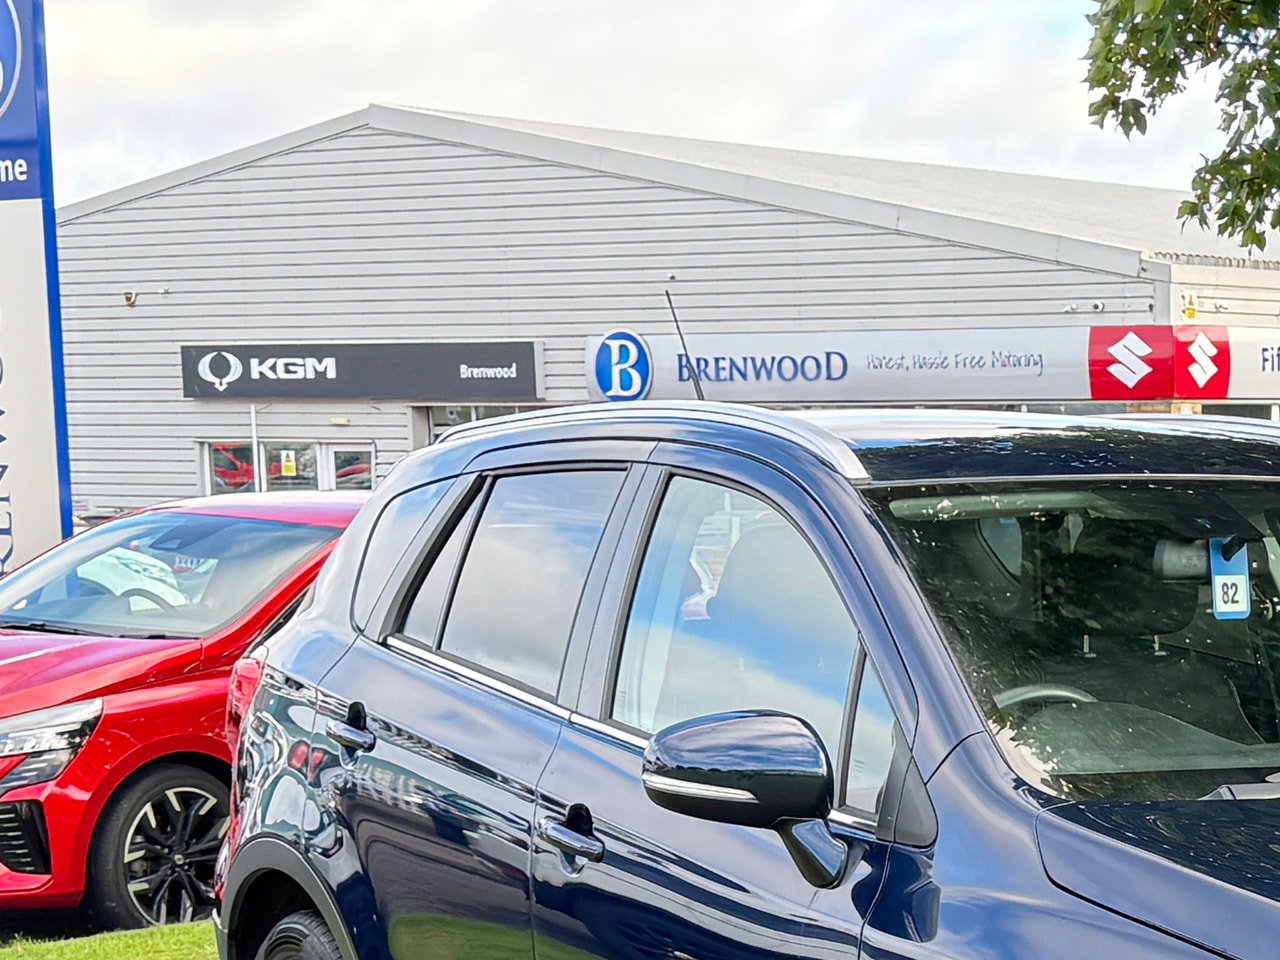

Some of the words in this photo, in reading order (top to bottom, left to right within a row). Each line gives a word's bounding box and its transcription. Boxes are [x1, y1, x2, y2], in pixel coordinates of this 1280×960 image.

[250, 357, 337, 380] KGM
[460, 364, 517, 379] Brenwood
[677, 351, 848, 382] BRENWOOD
[913, 350, 950, 370] Hassle
[954, 352, 986, 369] Free
[991, 350, 1044, 377] Motoring
[1221, 582, 1240, 605] 82
